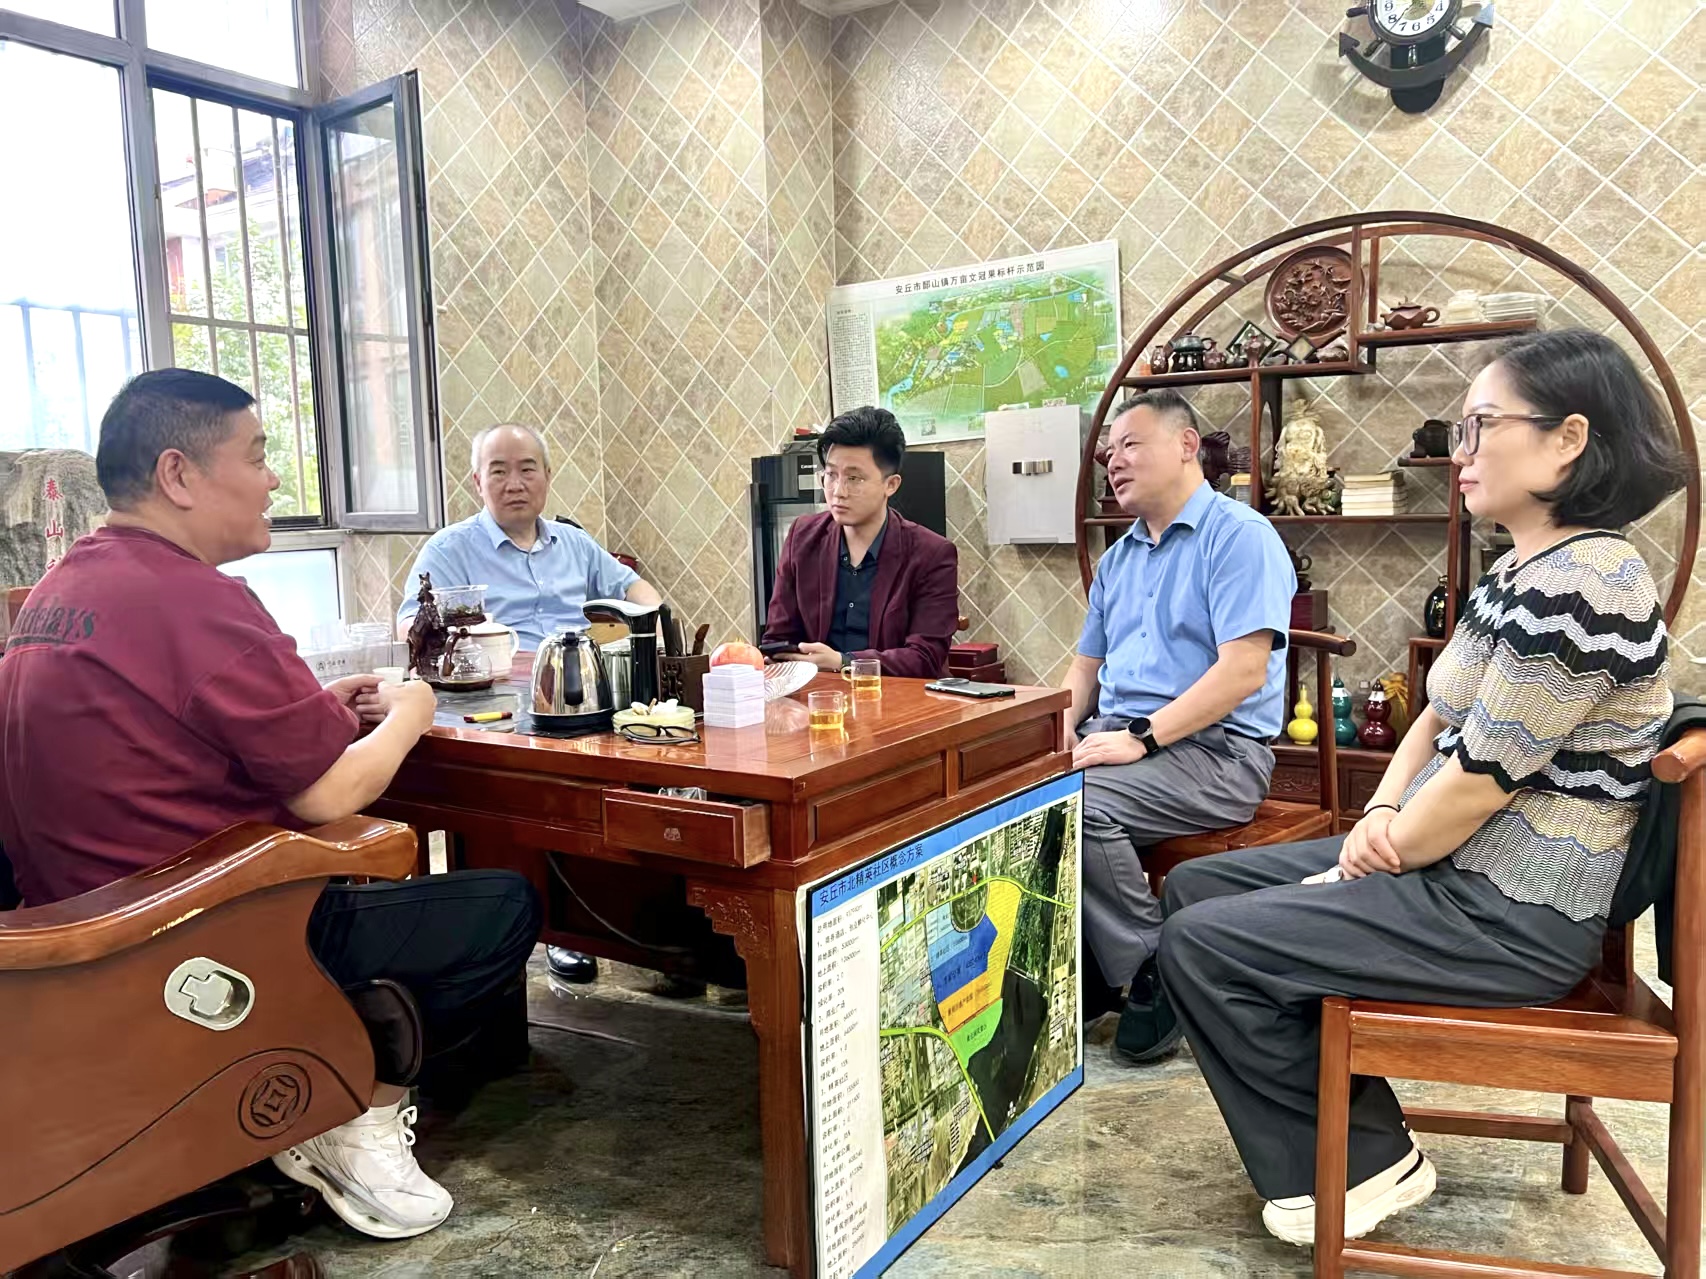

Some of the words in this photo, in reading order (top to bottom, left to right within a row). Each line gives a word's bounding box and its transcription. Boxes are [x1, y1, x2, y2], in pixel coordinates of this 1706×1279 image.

[820, 843, 924, 907] 安丘市北精英社区概念方案
